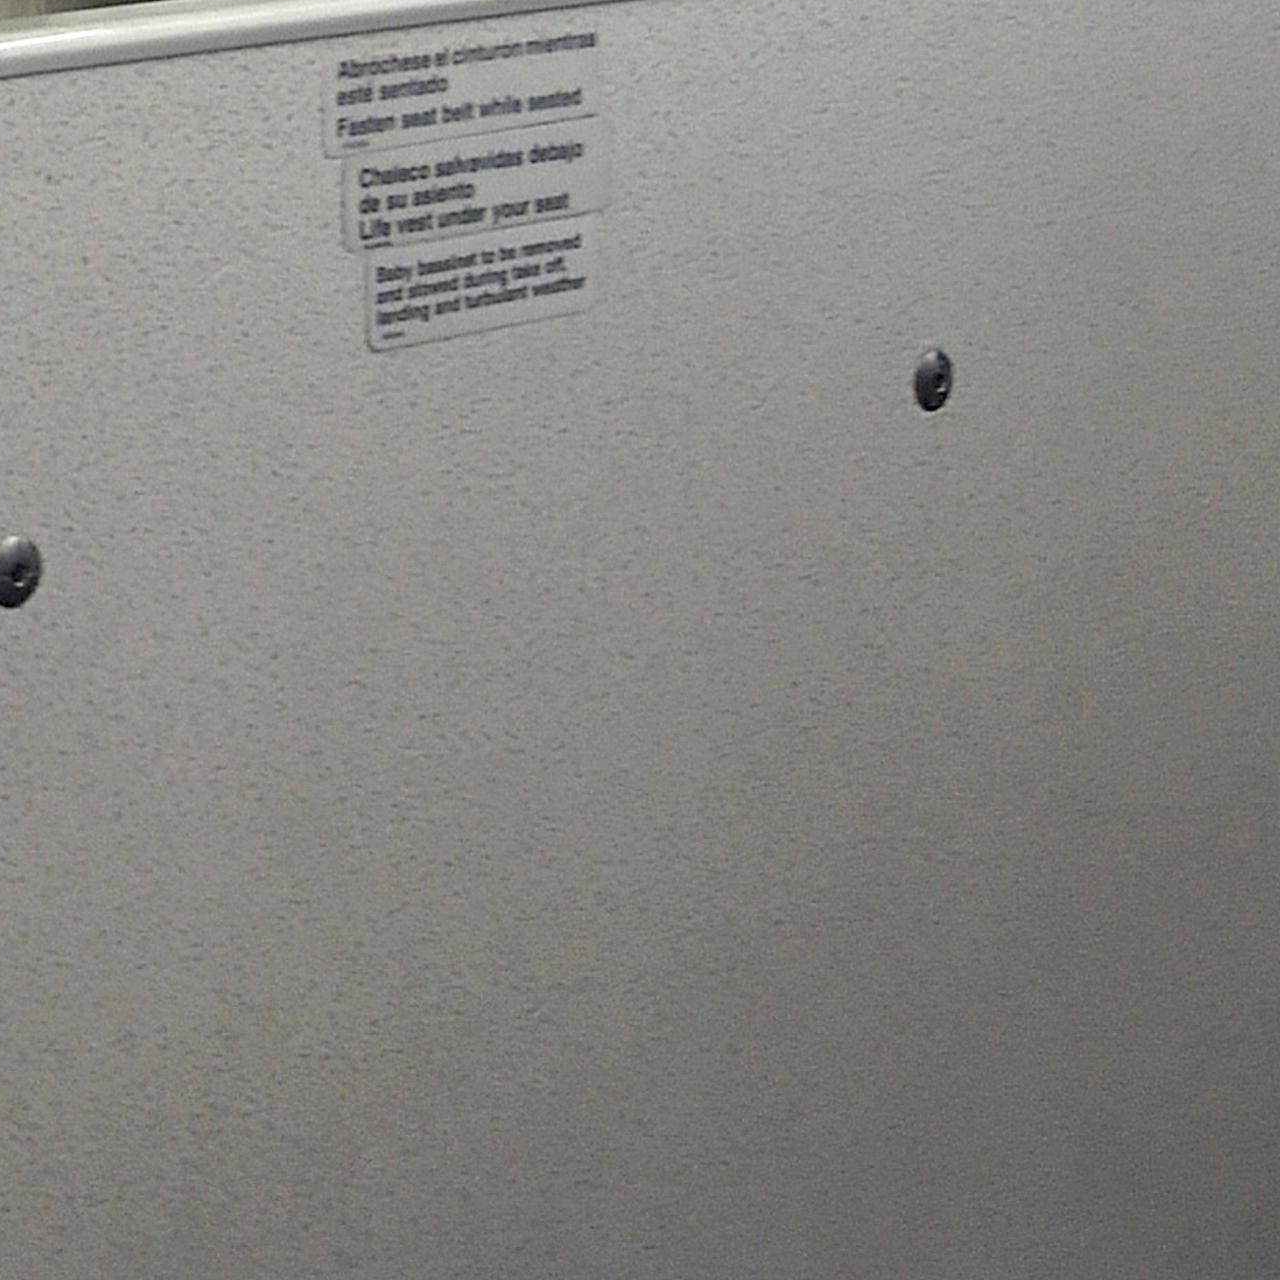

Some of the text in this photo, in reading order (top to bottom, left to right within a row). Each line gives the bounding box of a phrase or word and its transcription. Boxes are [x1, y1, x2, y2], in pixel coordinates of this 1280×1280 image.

[525, 32, 596, 55] mientras
[380, 74, 448, 102] sentado
[338, 87, 583, 138] Fasten seat belt while seated
[359, 142, 584, 189] Chaleco salvavidas debajo
[359, 191, 570, 241] Life vest under your seat
[360, 183, 476, 215] de su asiento
[376, 264, 413, 285] Baby
[520, 233, 582, 258] removed
[376, 287, 403, 305] and
[407, 276, 459, 300] stowed
[463, 269, 509, 291] during
[512, 263, 541, 281] take
[376, 275, 587, 327] landing and turbulent weather
